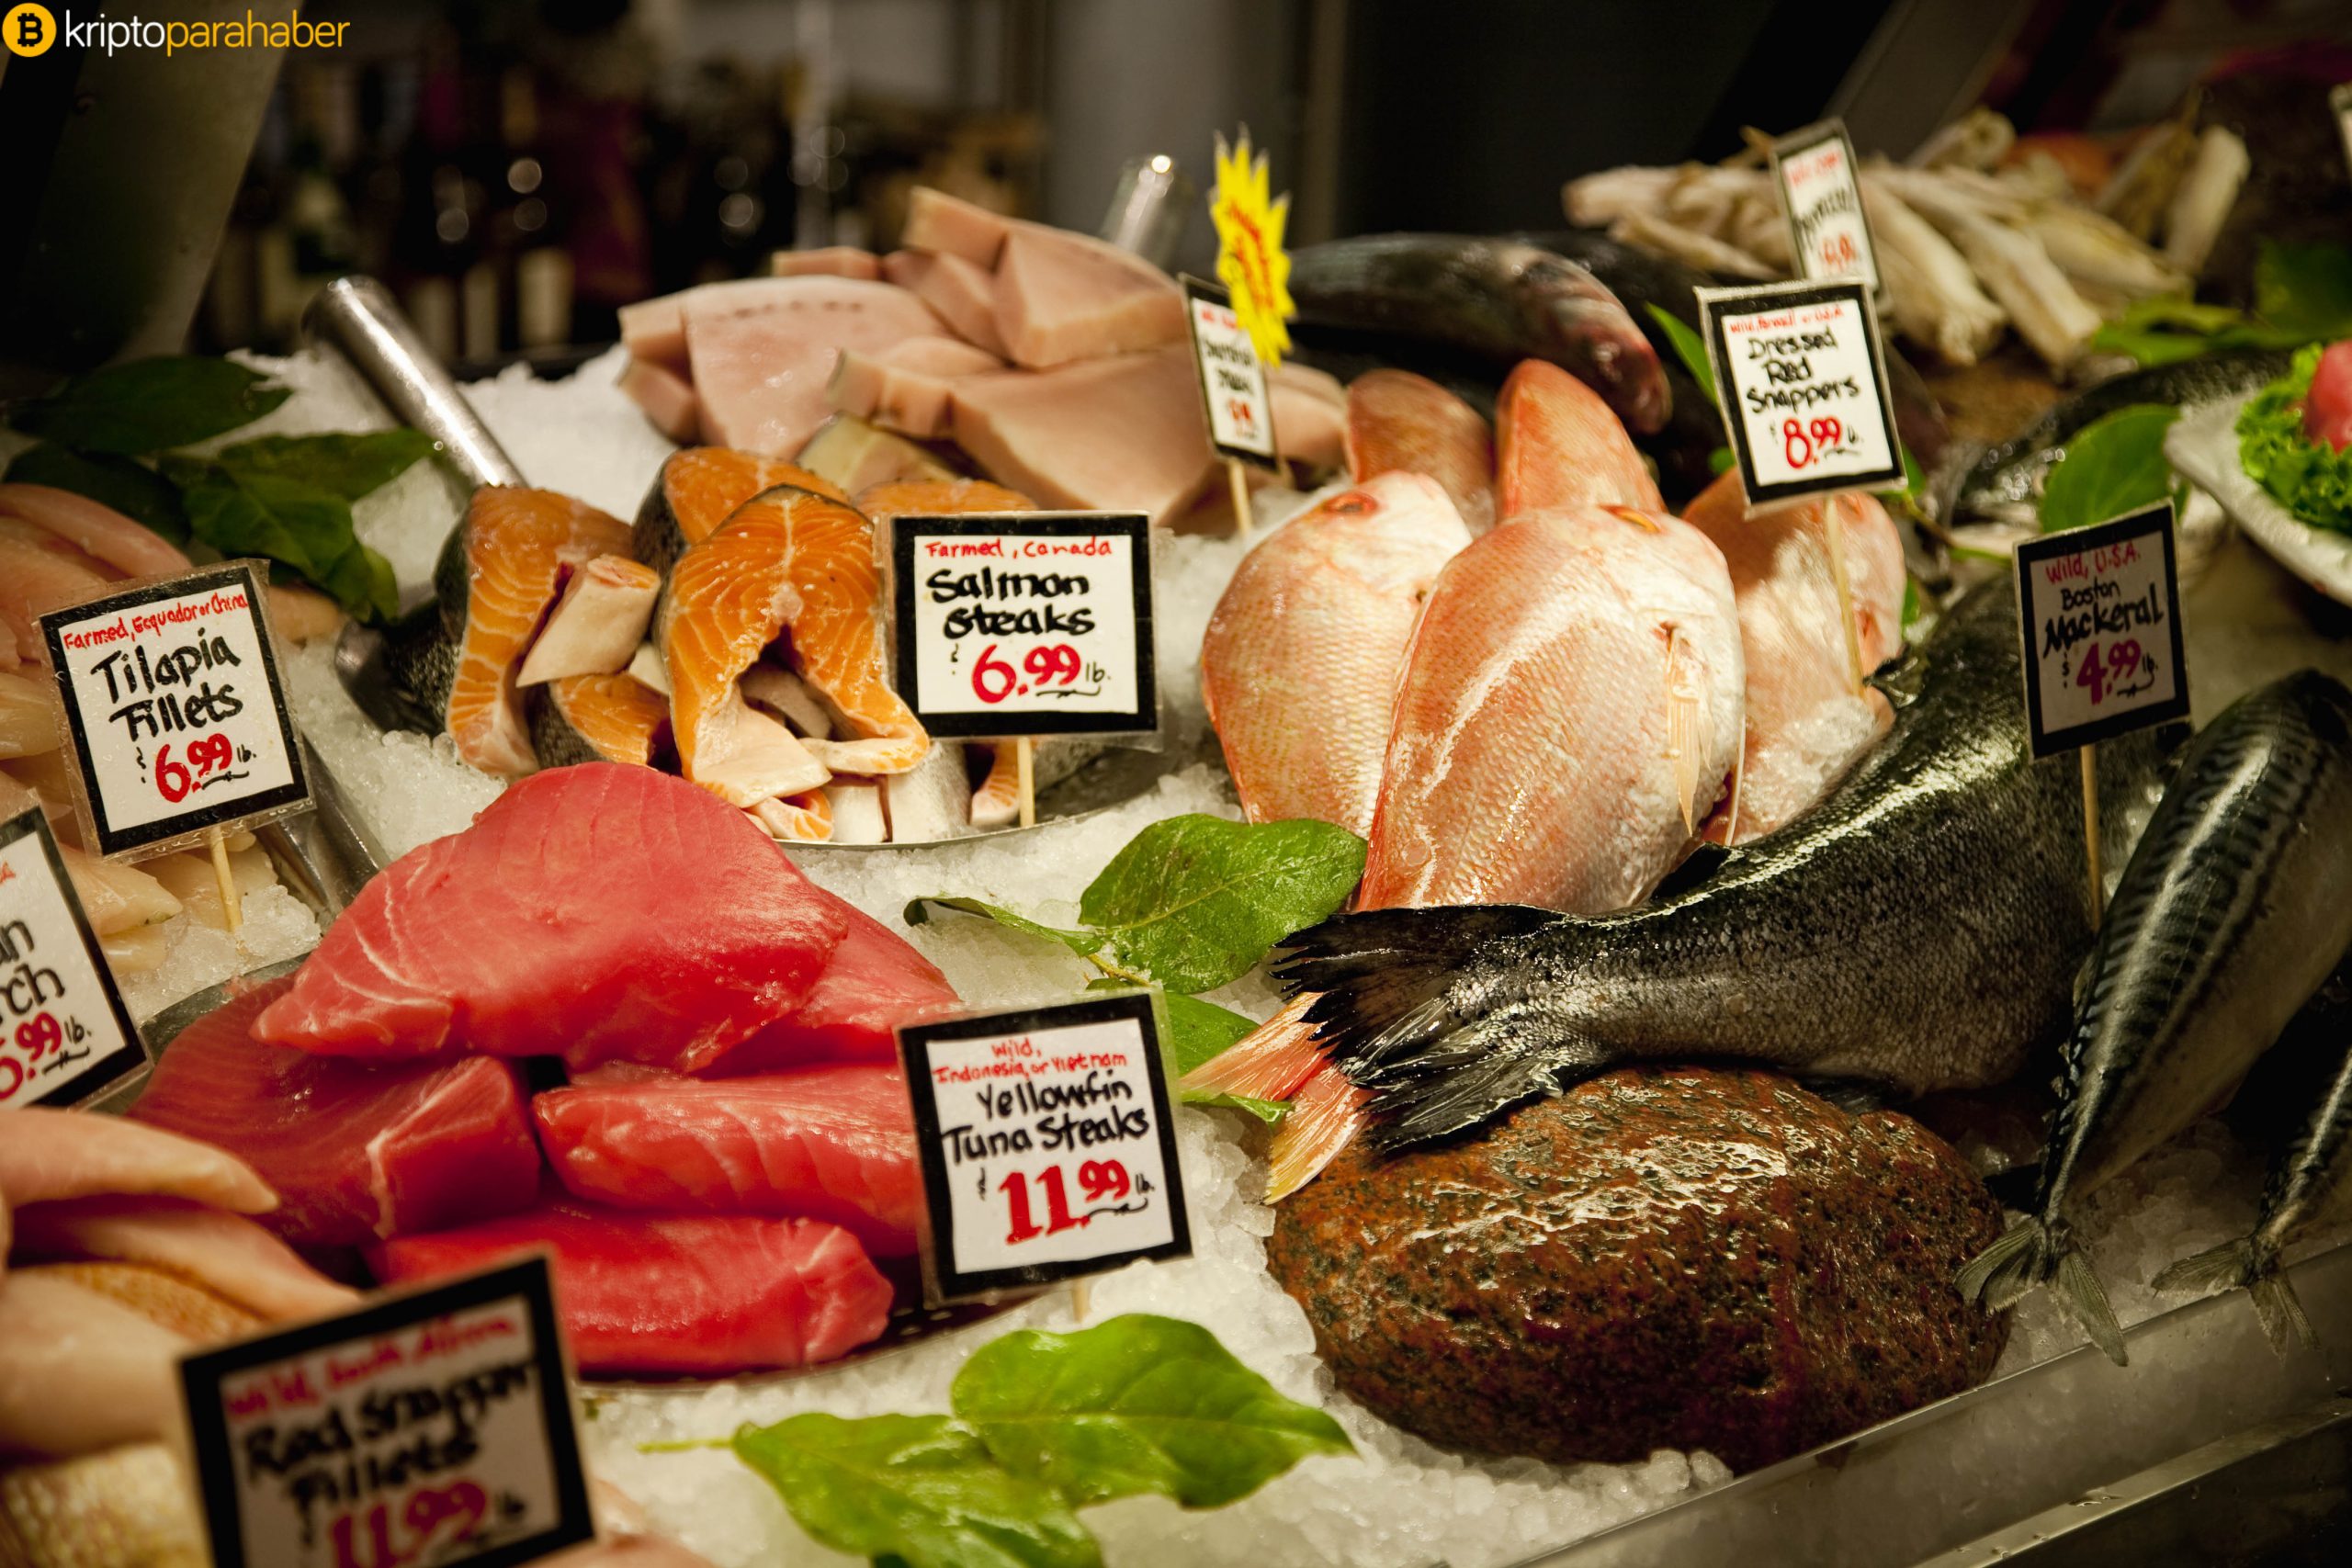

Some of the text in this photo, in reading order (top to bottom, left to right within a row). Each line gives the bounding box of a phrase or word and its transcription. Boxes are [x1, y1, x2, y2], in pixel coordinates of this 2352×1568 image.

[1747, 325, 1838, 360] Dressed
[1761, 355, 1813, 386] Red
[1747, 377, 1859, 413] Snappers
[926, 566, 1090, 604] Salmon
[2061, 577, 2120, 611] Boston
[2043, 582, 2164, 659] Mackeral
[91, 627, 241, 704] Tilapia
[972, 644, 1081, 704] 6.99
[108, 682, 243, 741] Fillets
[155, 733, 233, 803] 6.99
[941, 1104, 1150, 1165] Tuna Steaks
